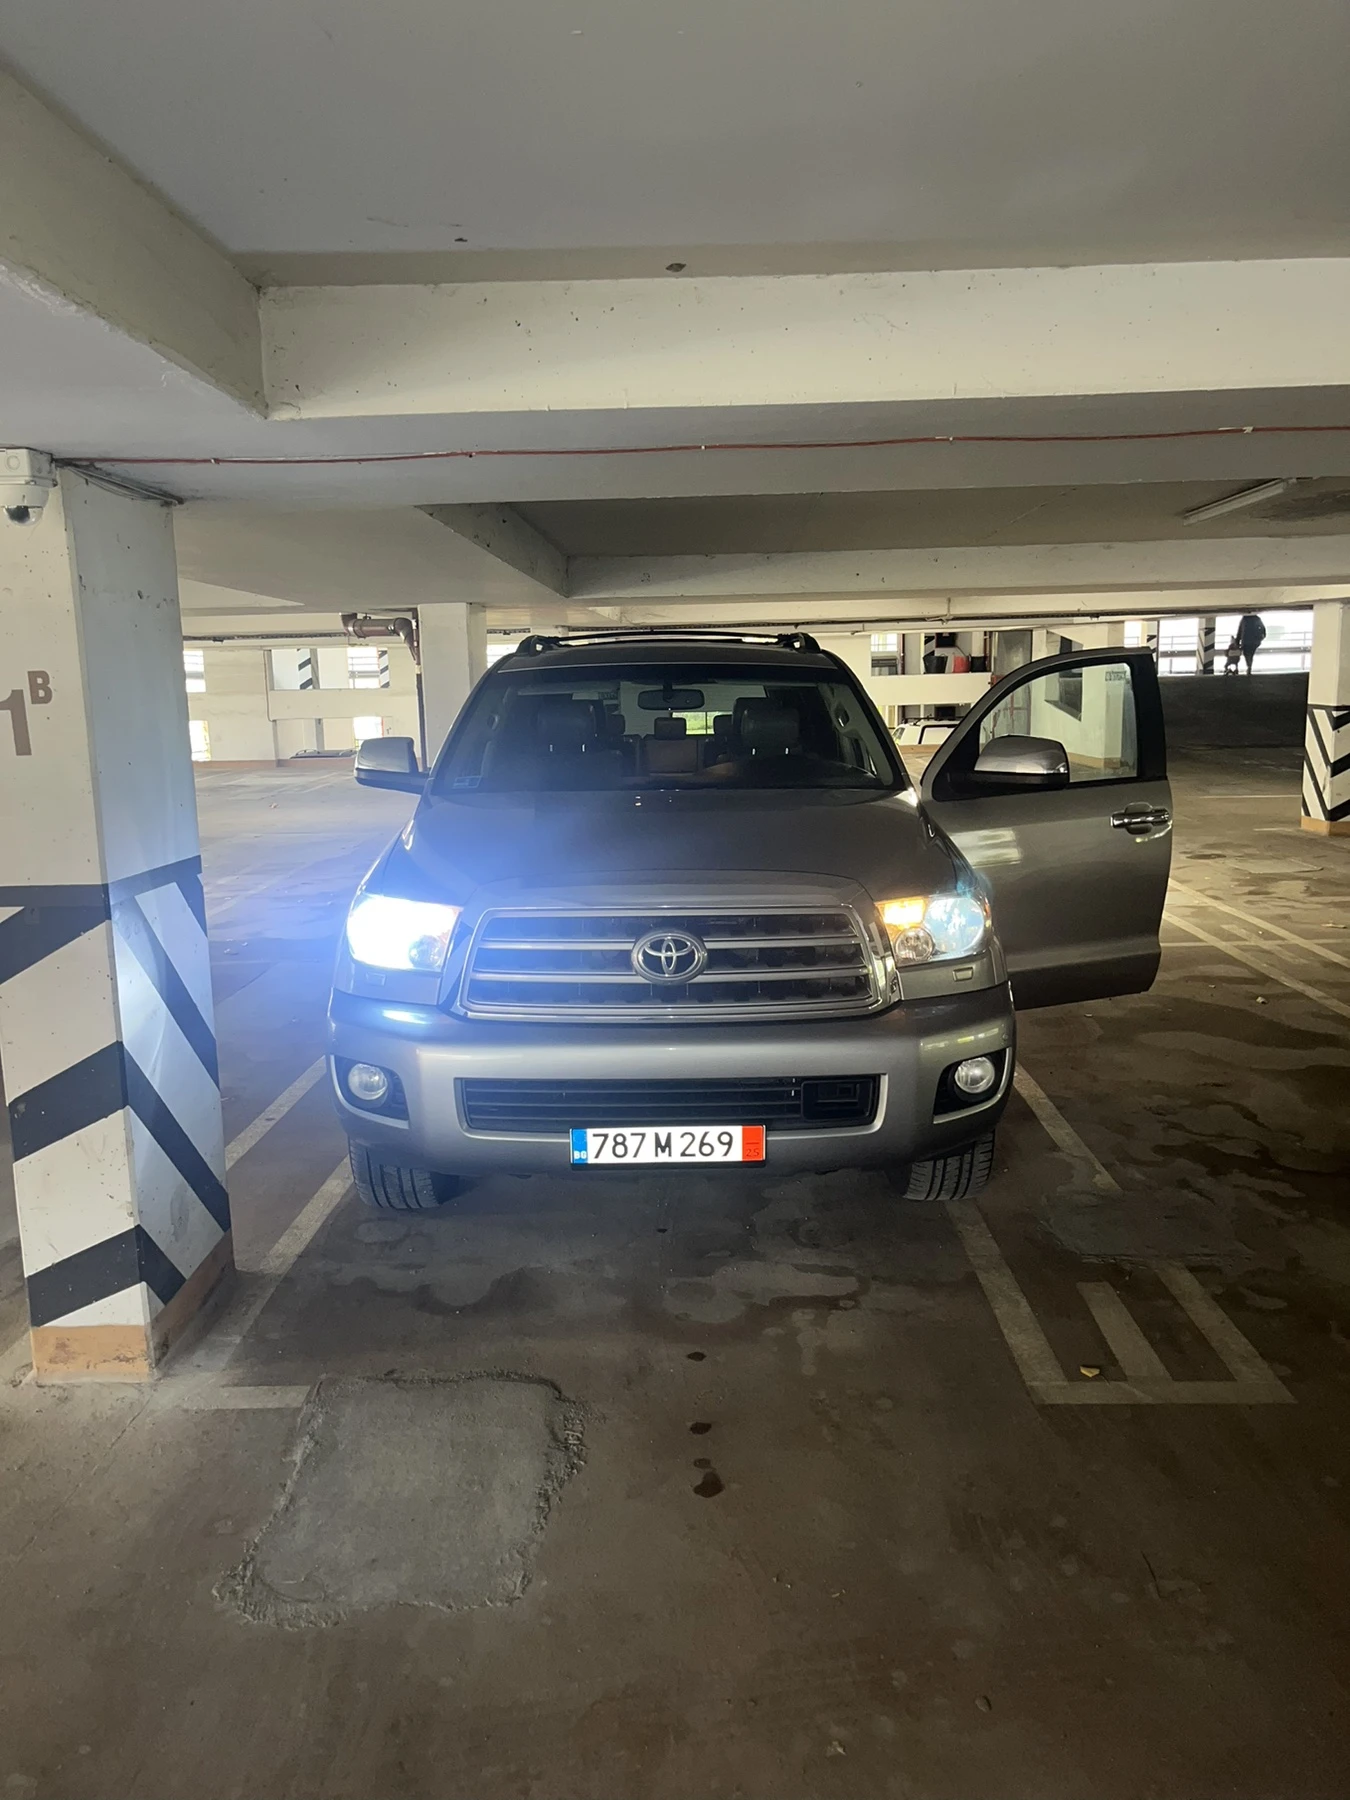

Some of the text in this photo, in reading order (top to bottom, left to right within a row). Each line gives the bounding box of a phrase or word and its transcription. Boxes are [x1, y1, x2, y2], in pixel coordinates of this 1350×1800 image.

[592, 1131, 734, 1159] 787 M 269
[573, 1150, 587, 1160] BG
